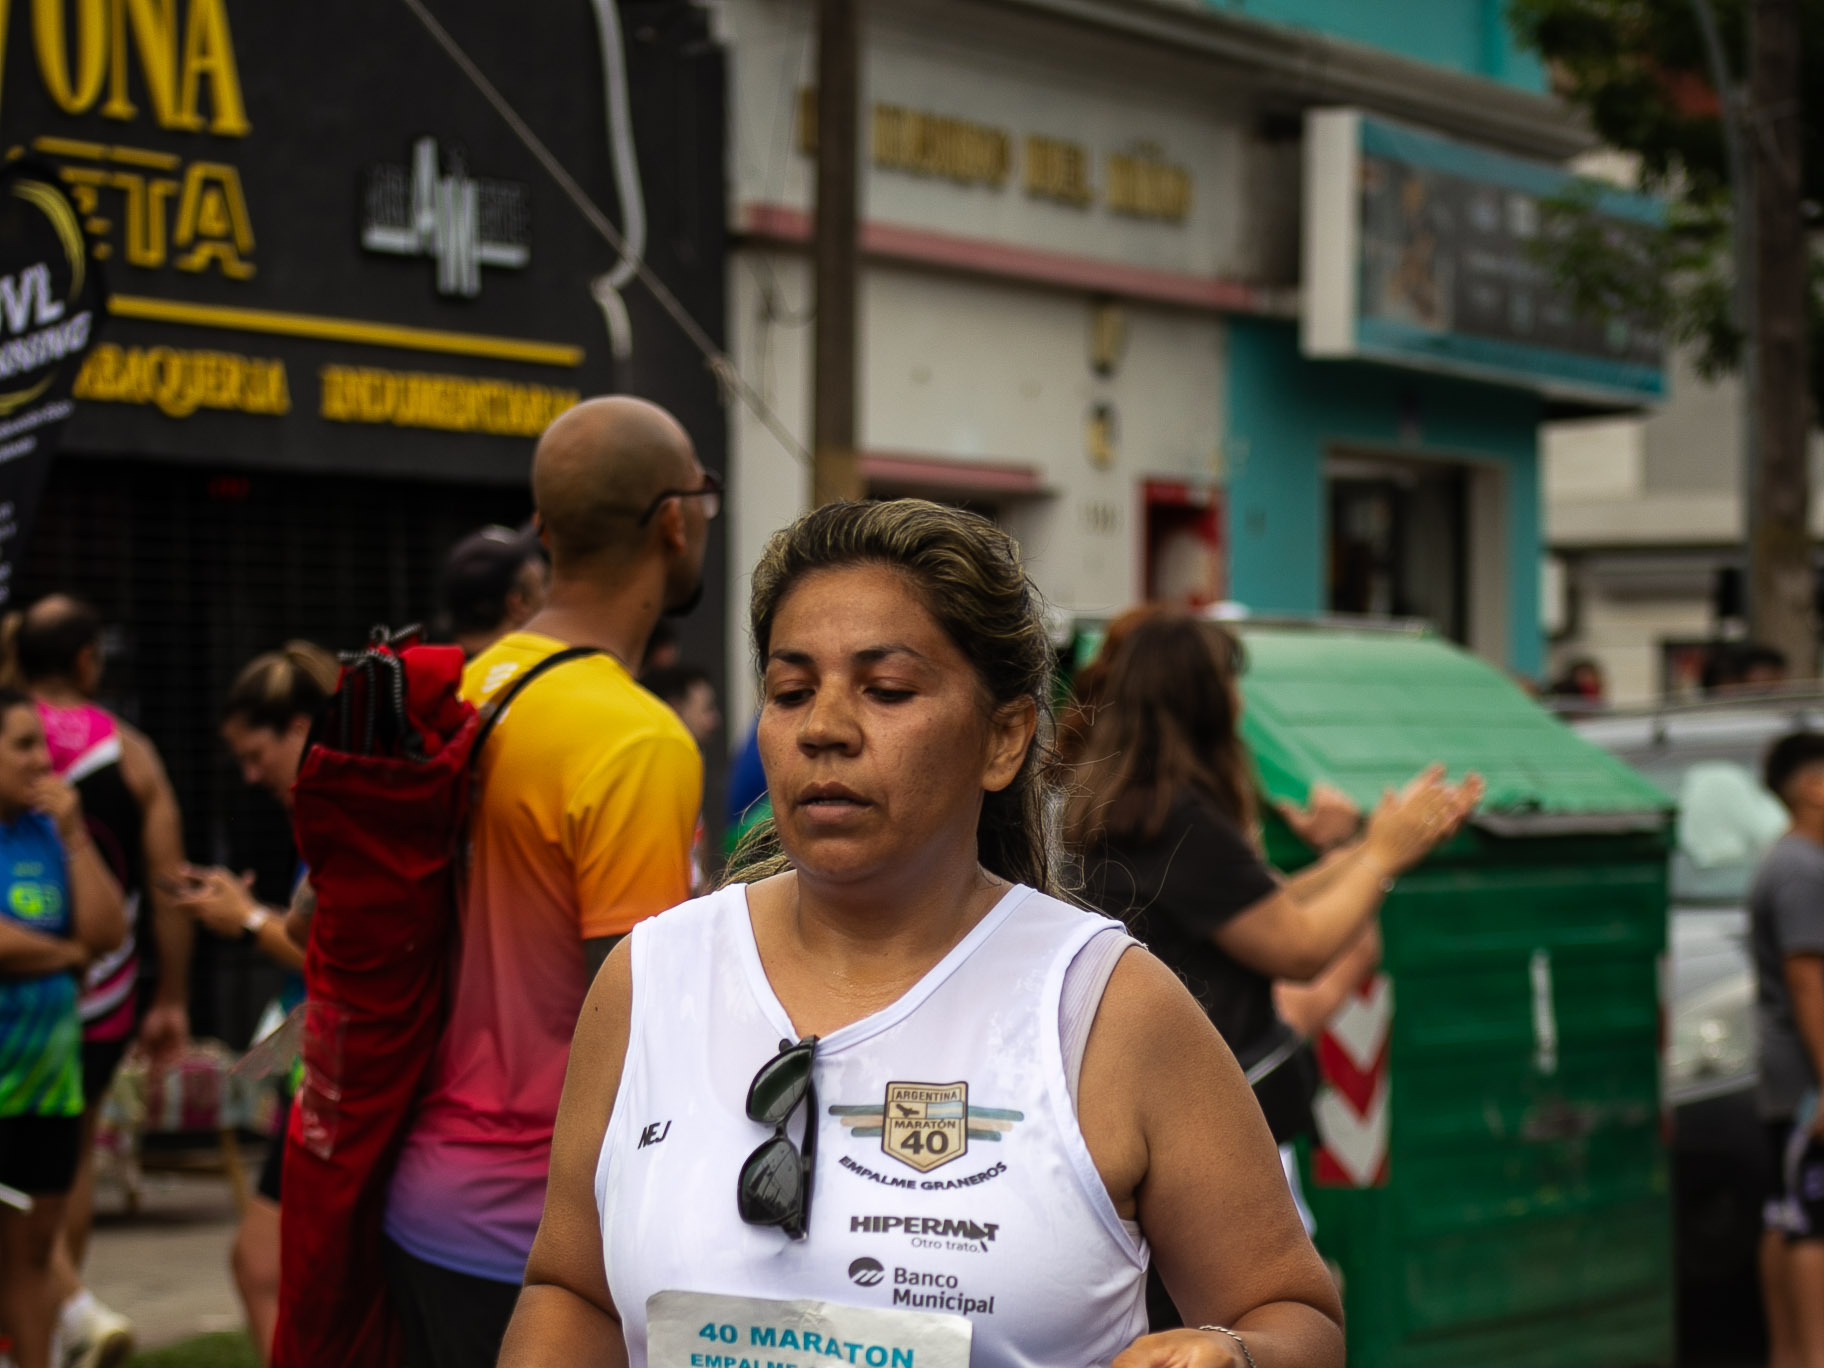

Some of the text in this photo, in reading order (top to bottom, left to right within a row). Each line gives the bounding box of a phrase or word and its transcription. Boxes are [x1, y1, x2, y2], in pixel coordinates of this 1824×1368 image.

[895, 1087, 959, 1102] ARGENTINA
[637, 1119, 672, 1150] NEJ
[894, 1115, 957, 1131] MARATÓN
[899, 1130, 950, 1156] 40
[838, 1154, 1009, 1191] EMPALME GRANEROS
[910, 1236, 943, 1251] Otro
[893, 1267, 959, 1289] Banco
[892, 1287, 995, 1317] Municipal
[698, 1322, 739, 1345] 40
